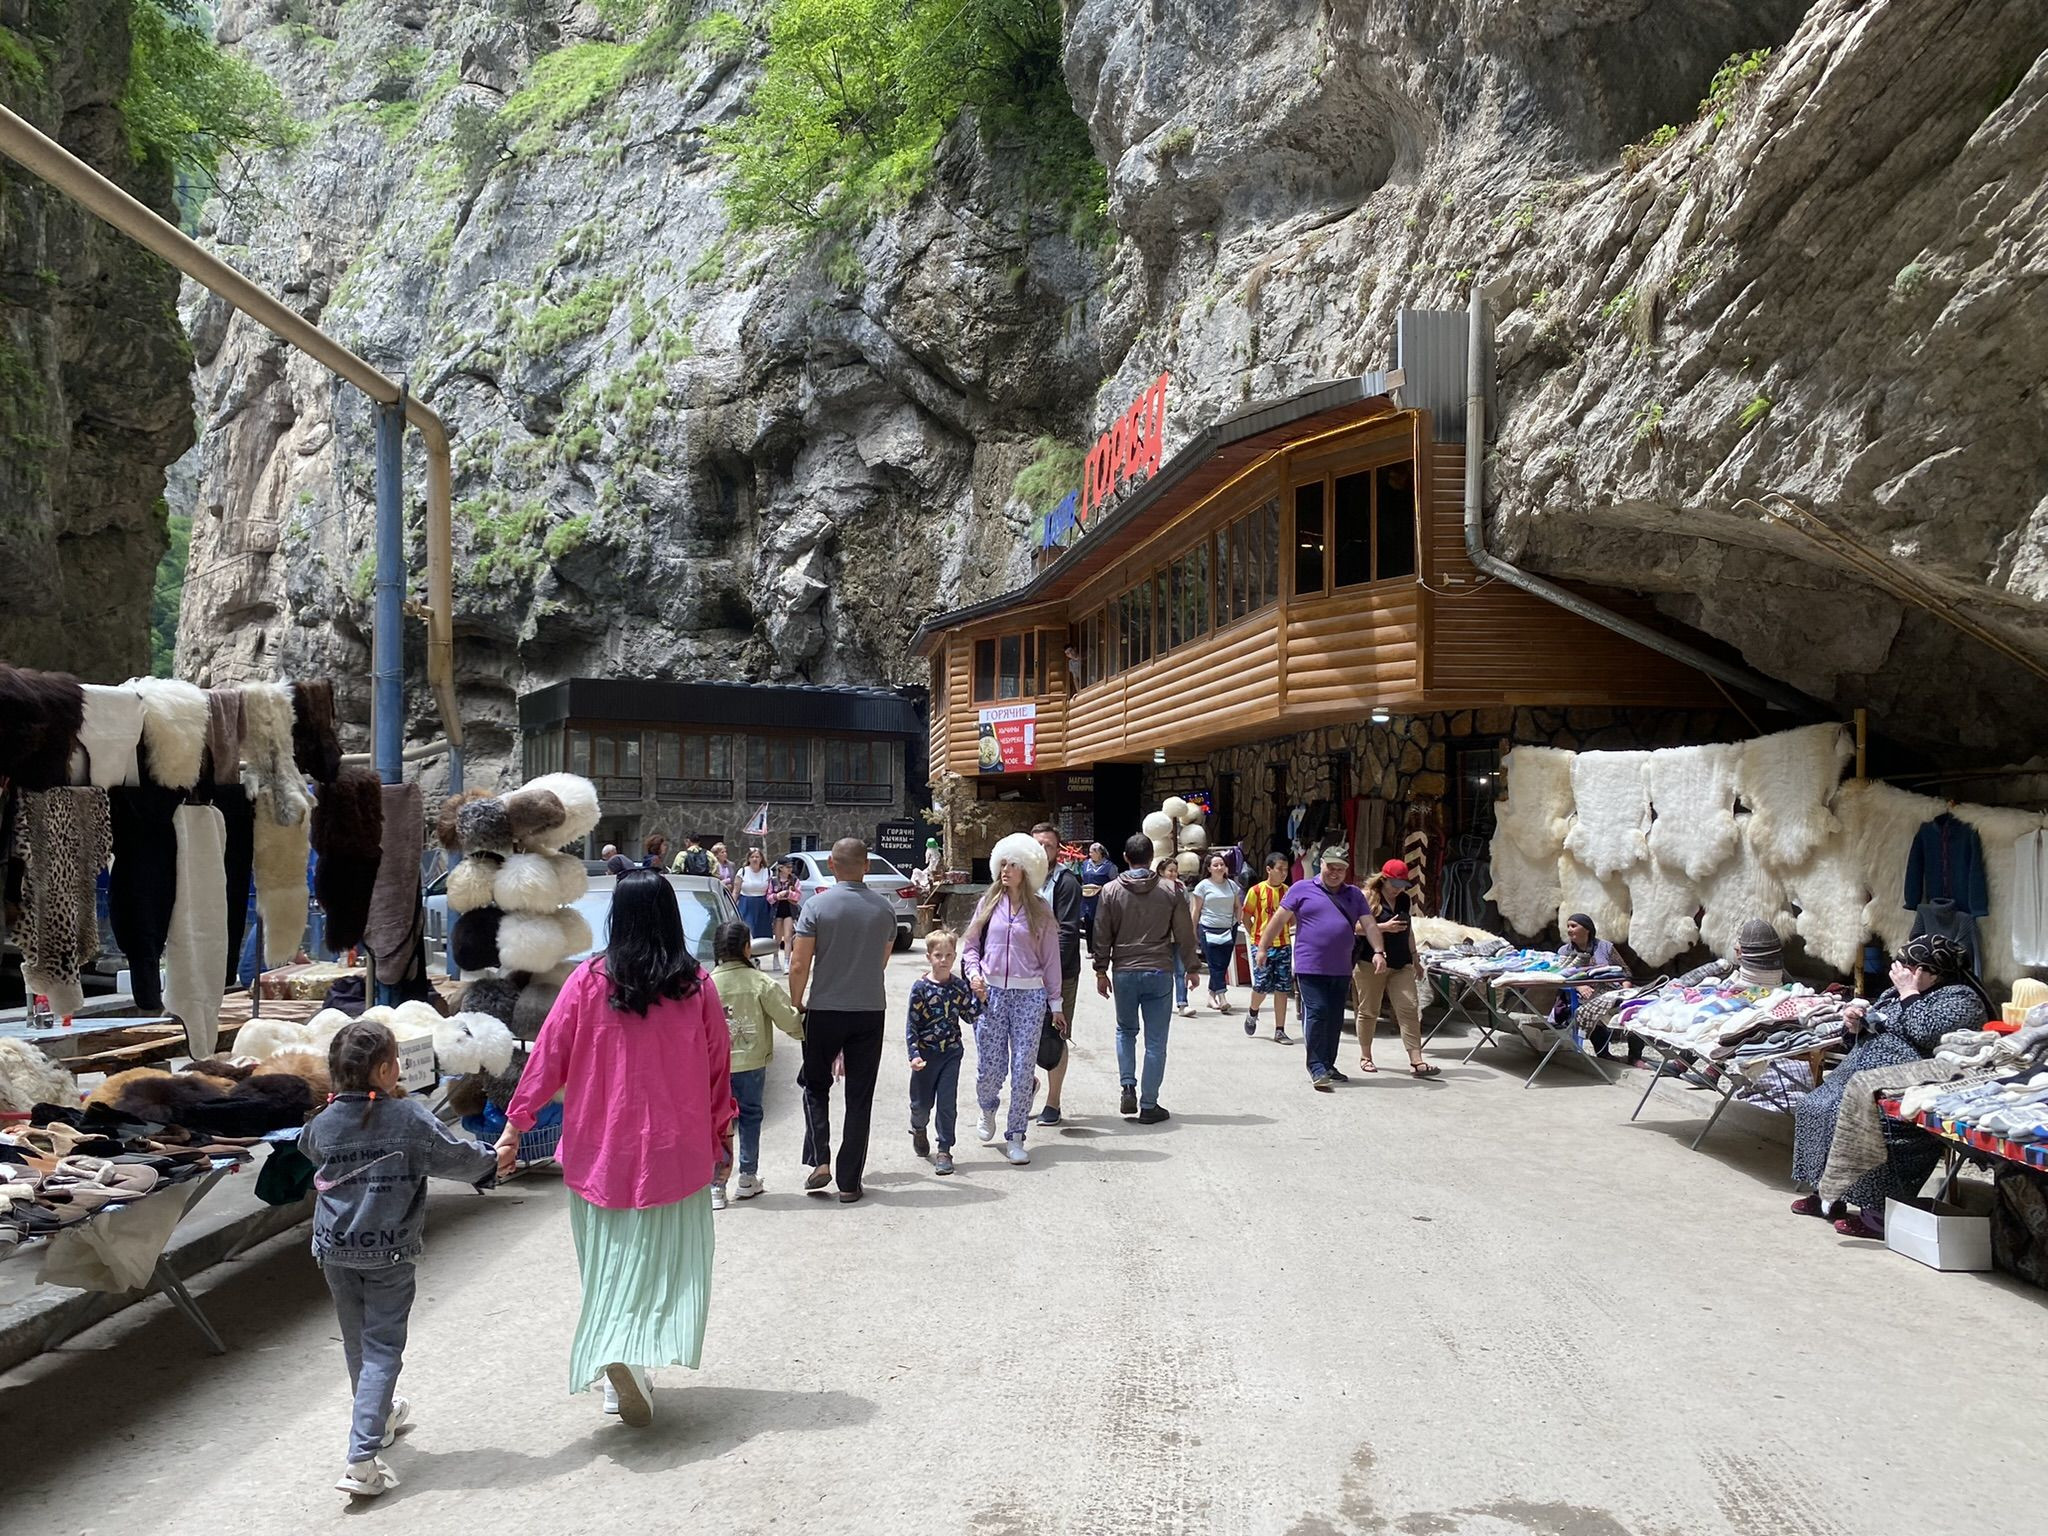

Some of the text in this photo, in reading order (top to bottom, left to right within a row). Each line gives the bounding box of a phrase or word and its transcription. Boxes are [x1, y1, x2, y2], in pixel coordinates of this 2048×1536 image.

[1081, 370, 1169, 522] ГОРЕЦ
[986, 707, 1028, 721] ГОРЯЧИЕ
[1068, 776, 1094, 785] МАГНИТ
